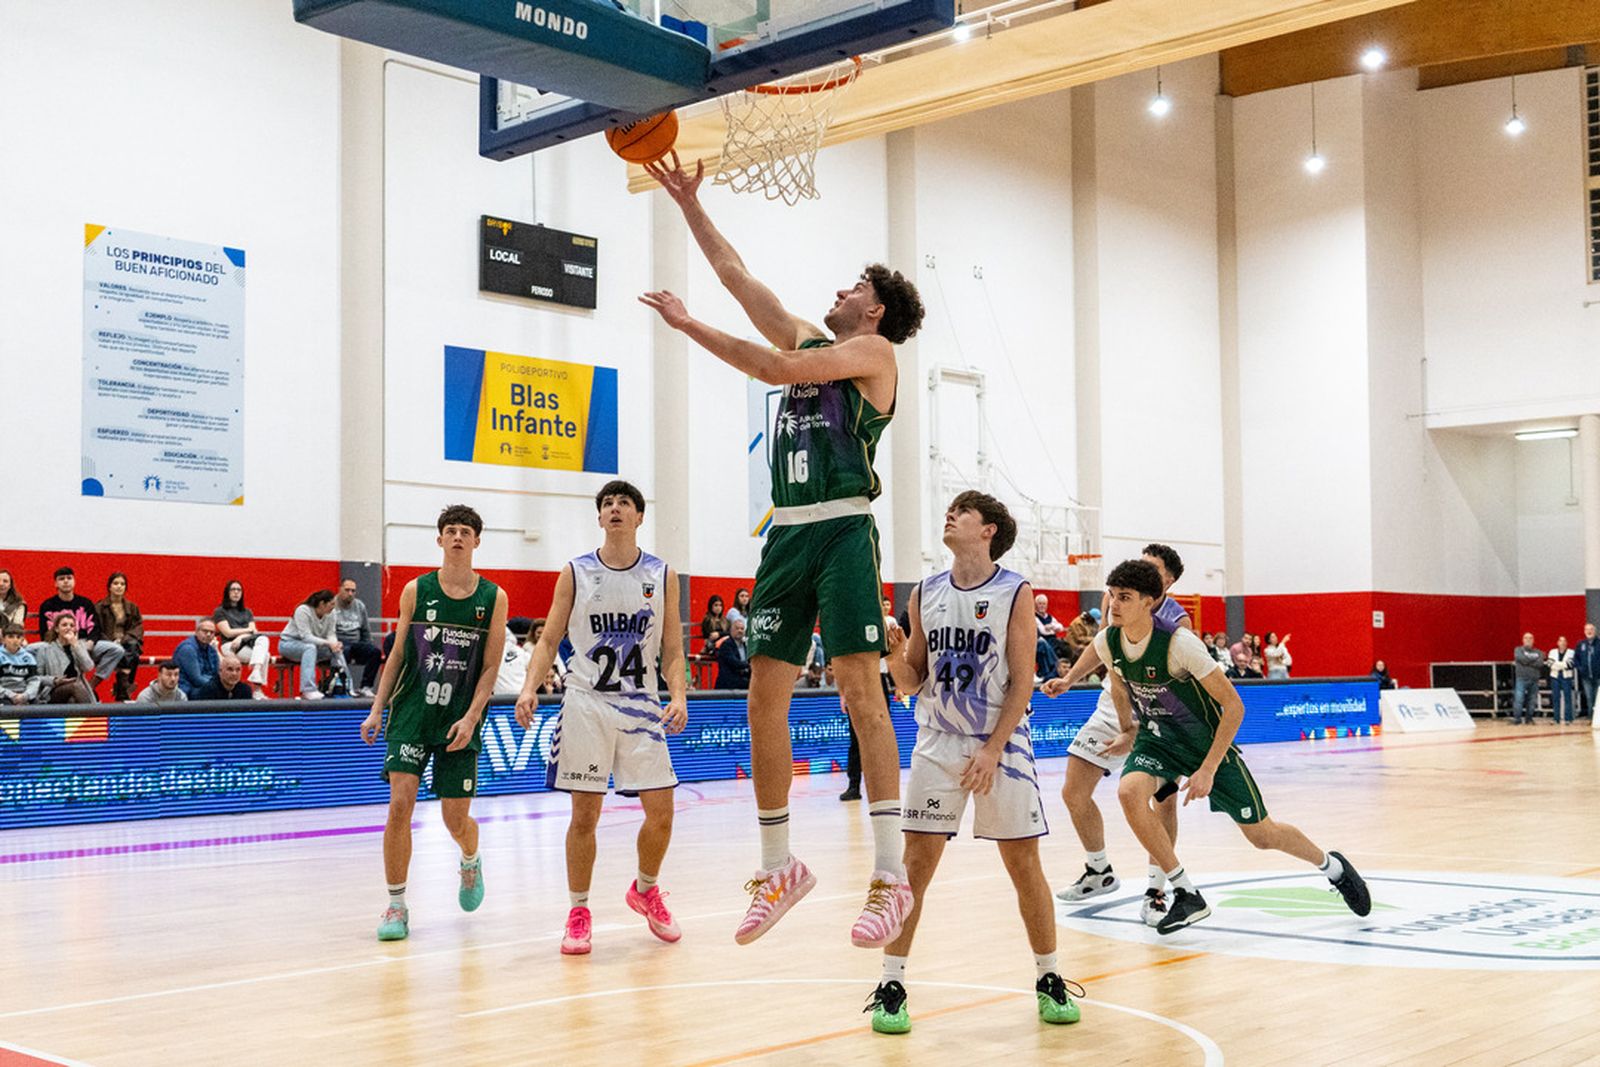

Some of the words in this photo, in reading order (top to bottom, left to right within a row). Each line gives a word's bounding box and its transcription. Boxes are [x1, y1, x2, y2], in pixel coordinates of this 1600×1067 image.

[514, 1, 590, 41] MONDO
[106, 246, 130, 260] LOS
[131, 250, 203, 271] PRINCIPIOS
[205, 262, 227, 275] DEL
[489, 248, 521, 265] LOCAL
[115, 260, 148, 275] BUEN
[149, 265, 220, 286] AFICIONADO
[563, 263, 594, 279] VISITANTE
[530, 284, 554, 298] PERIODO
[499, 362, 569, 381] POLIDEPORTIVO
[509, 382, 560, 410] Blas
[491, 407, 578, 438] Infante
[786, 449, 809, 485] 16
[442, 627, 480, 641] Fundación
[589, 613, 650, 635] BILBAO
[442, 636, 471, 648] Unicaja
[928, 625, 992, 656] BILBAO
[591, 643, 648, 693] 24
[936, 660, 976, 693] 49
[424, 680, 454, 707] 99
[907, 809, 920, 819] SR
